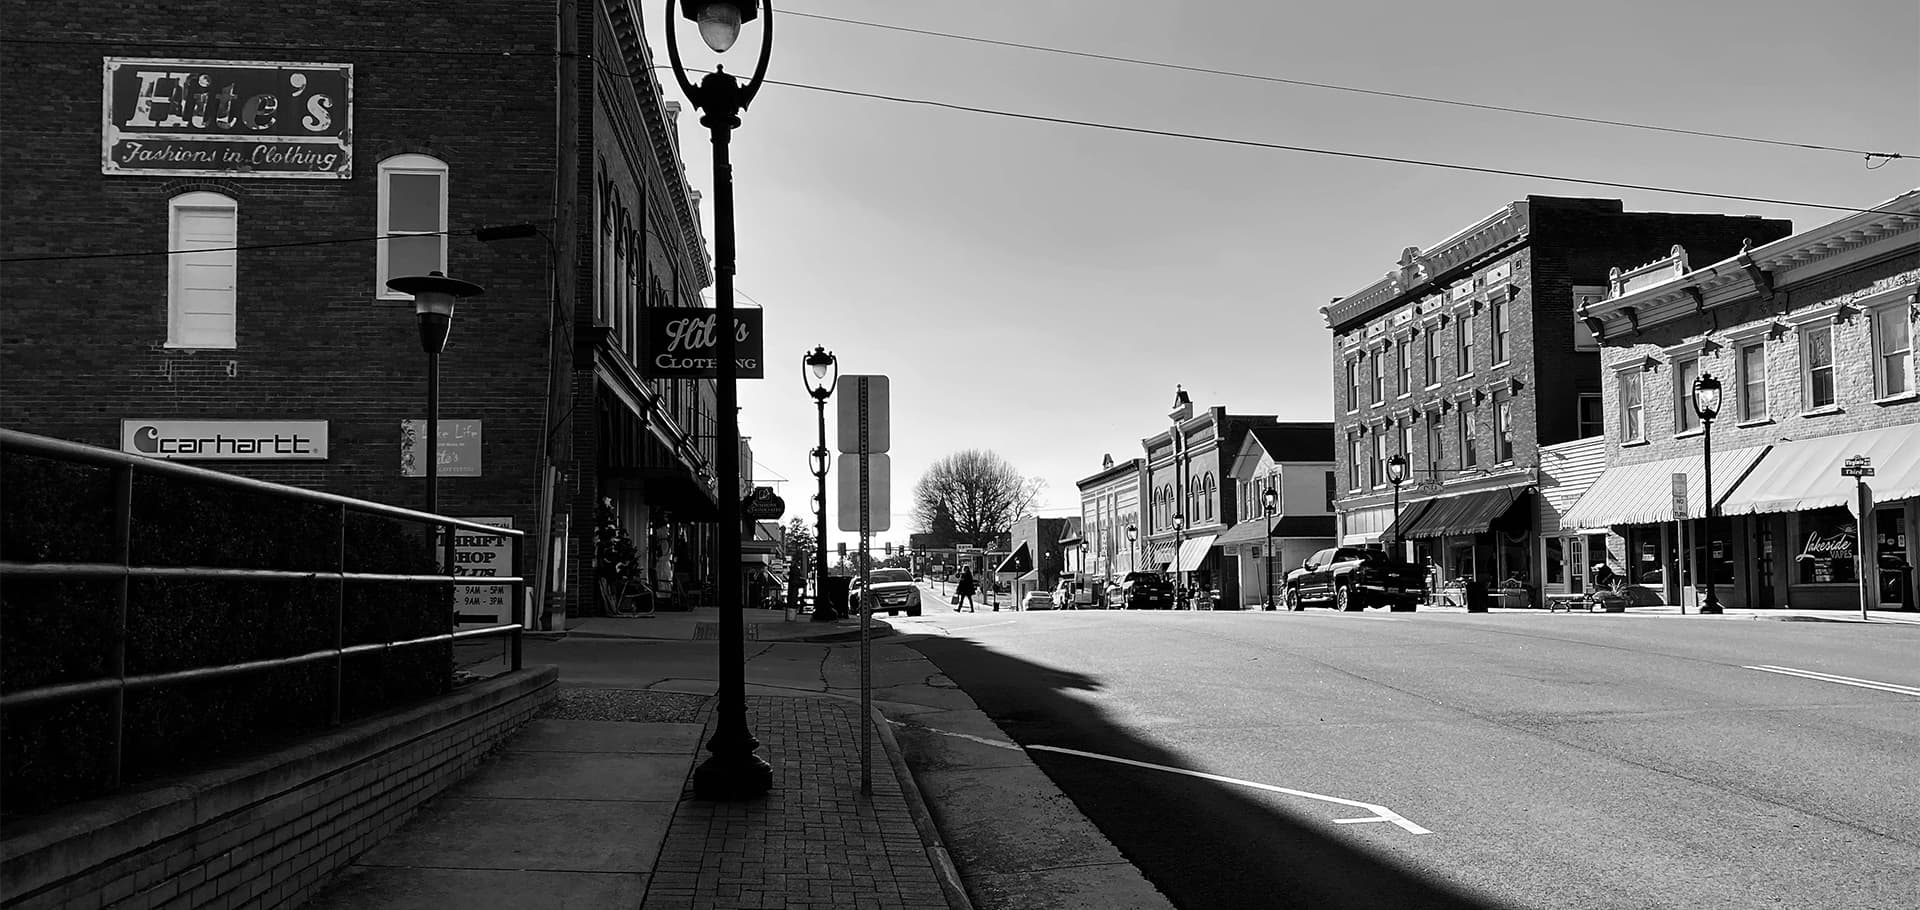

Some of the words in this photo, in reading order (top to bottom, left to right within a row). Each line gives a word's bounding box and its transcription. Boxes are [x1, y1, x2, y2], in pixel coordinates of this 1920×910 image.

[125, 71, 333, 132] Hite's
[122, 142, 216, 163] Fashions
[222, 147, 242, 163] in
[252, 145, 338, 171] Clothing
[665, 313, 750, 352] Hit's
[655, 353, 757, 369] CLOTHNG
[159, 434, 310, 454] carhartt
[1795, 530, 1852, 562] Lakeside
[1830, 549, 1853, 559] VAPES
[455, 551, 496, 564] HOP
[465, 586, 481, 594] 9AM
[464, 597, 481, 606] 9AM
